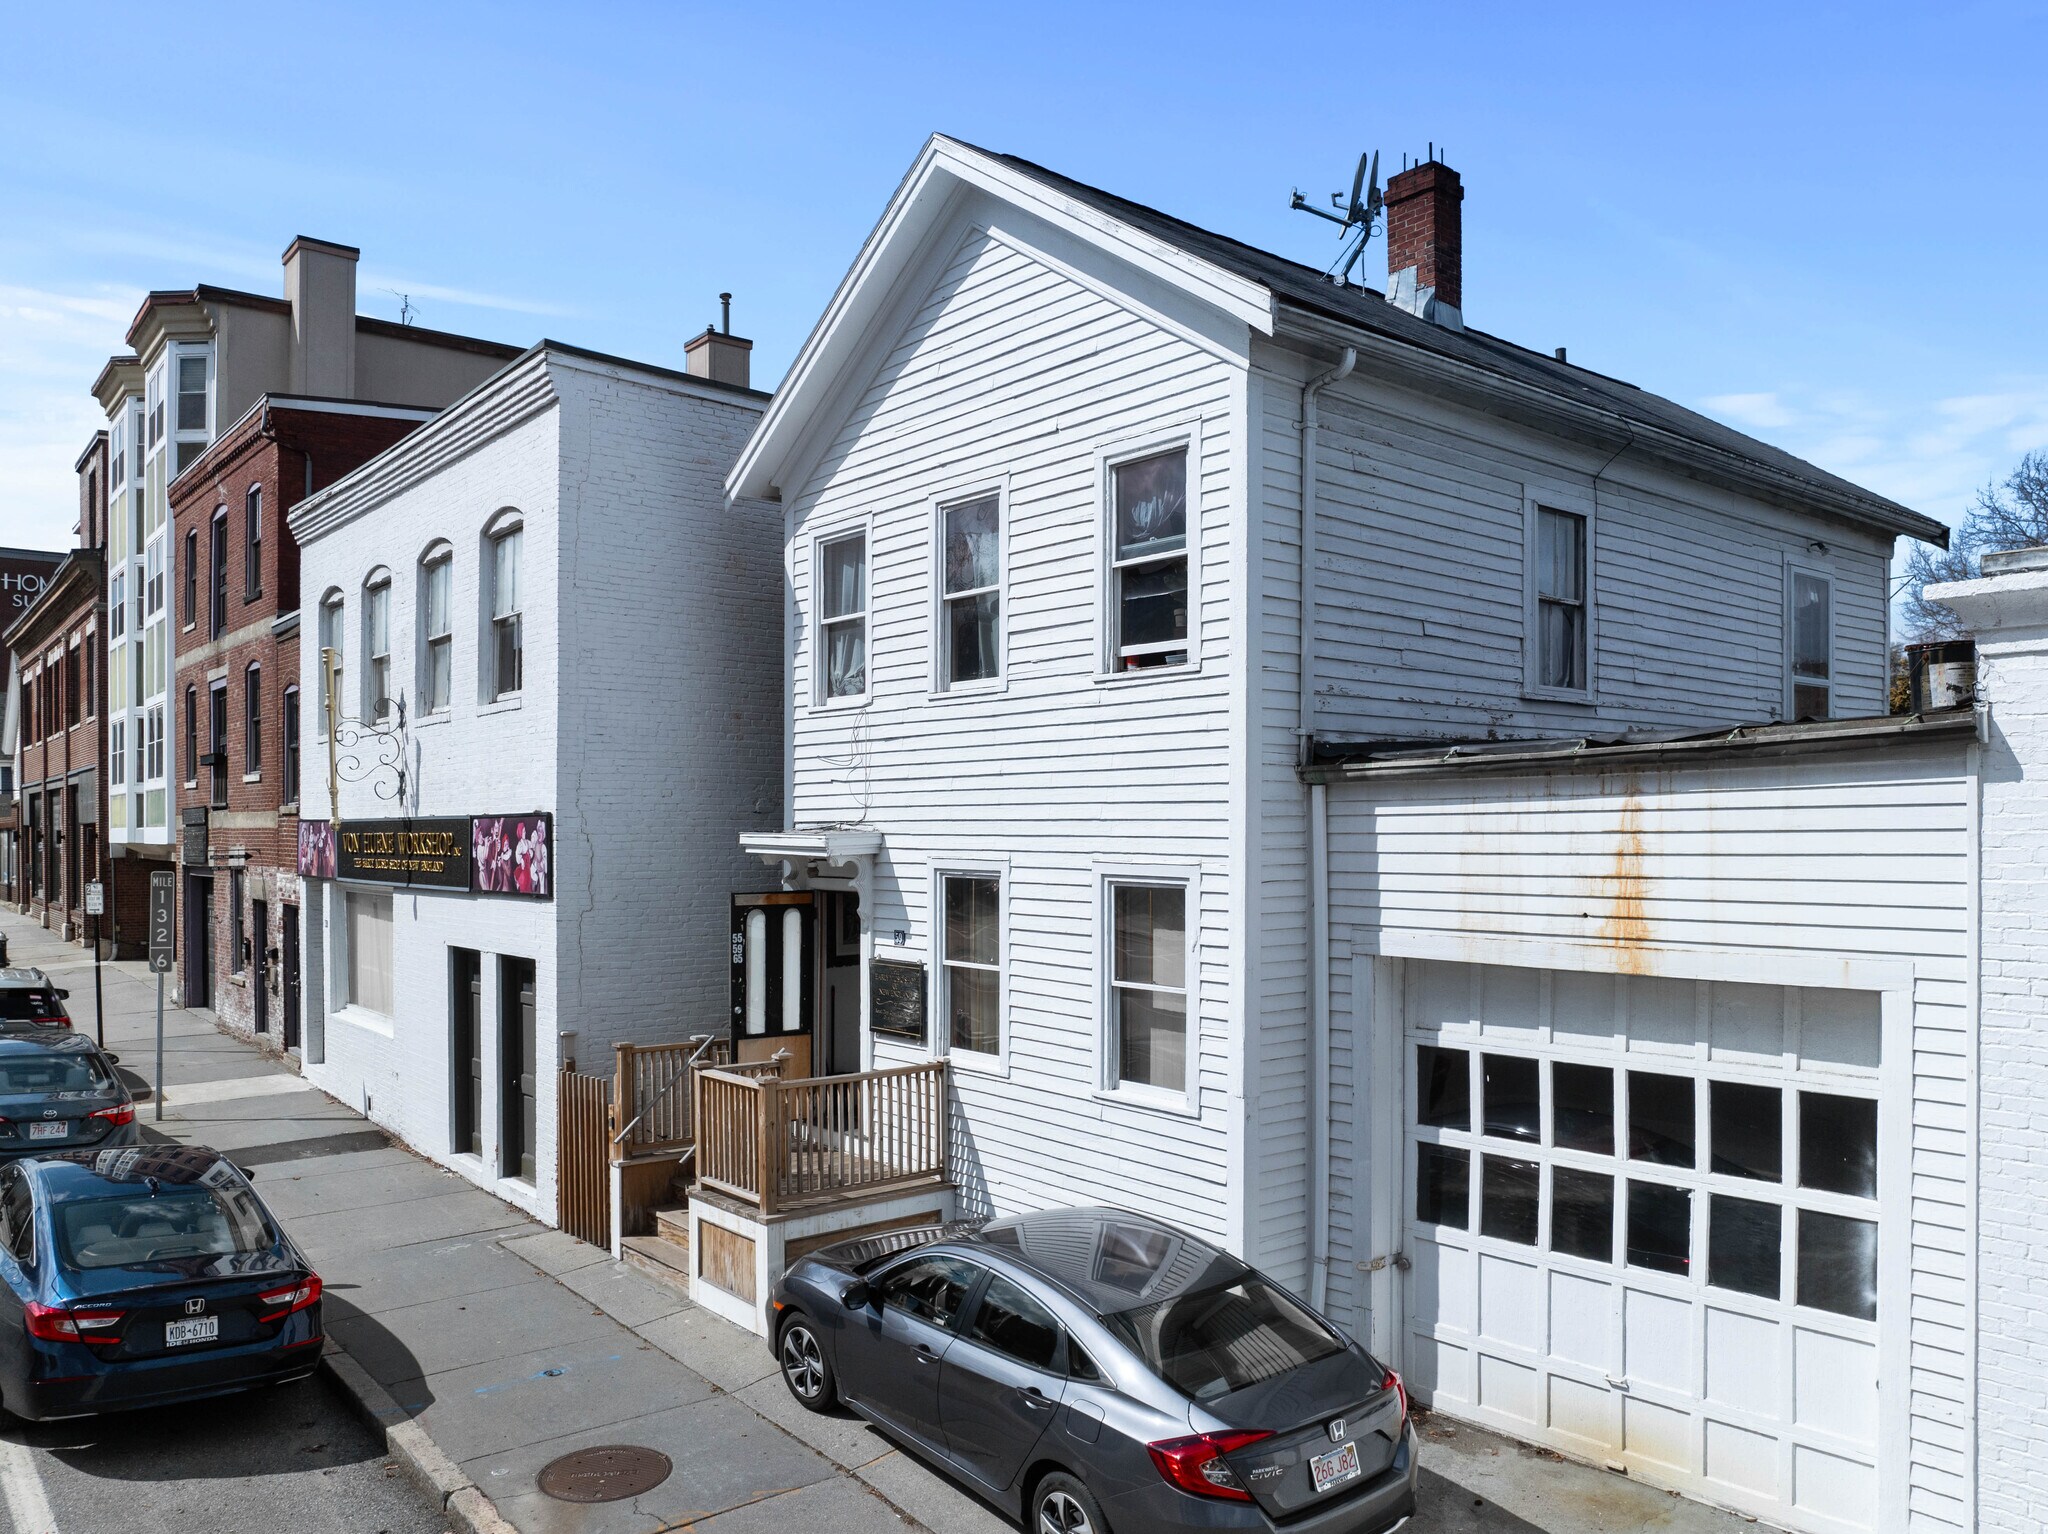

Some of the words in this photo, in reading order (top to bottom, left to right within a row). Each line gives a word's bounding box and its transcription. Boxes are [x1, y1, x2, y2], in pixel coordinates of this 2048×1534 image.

[342, 831, 360, 853] VON
[363, 831, 395, 854] HUENE
[397, 831, 454, 856] WORKSHOP
[152, 877, 173, 887] MILE
[732, 932, 743, 943] 55
[732, 943, 743, 954] 59
[732, 953, 743, 964] 65
[32, 1125, 48, 1136] 7HF
[49, 1125, 66, 1135] 244
[73, 1302, 112, 1310] ACCORD
[189, 1335, 218, 1344] HONDA
[1314, 1461, 1335, 1483] 26G
[1336, 1452, 1356, 1474] J82
[1250, 1468, 1283, 1480] CIVIC
